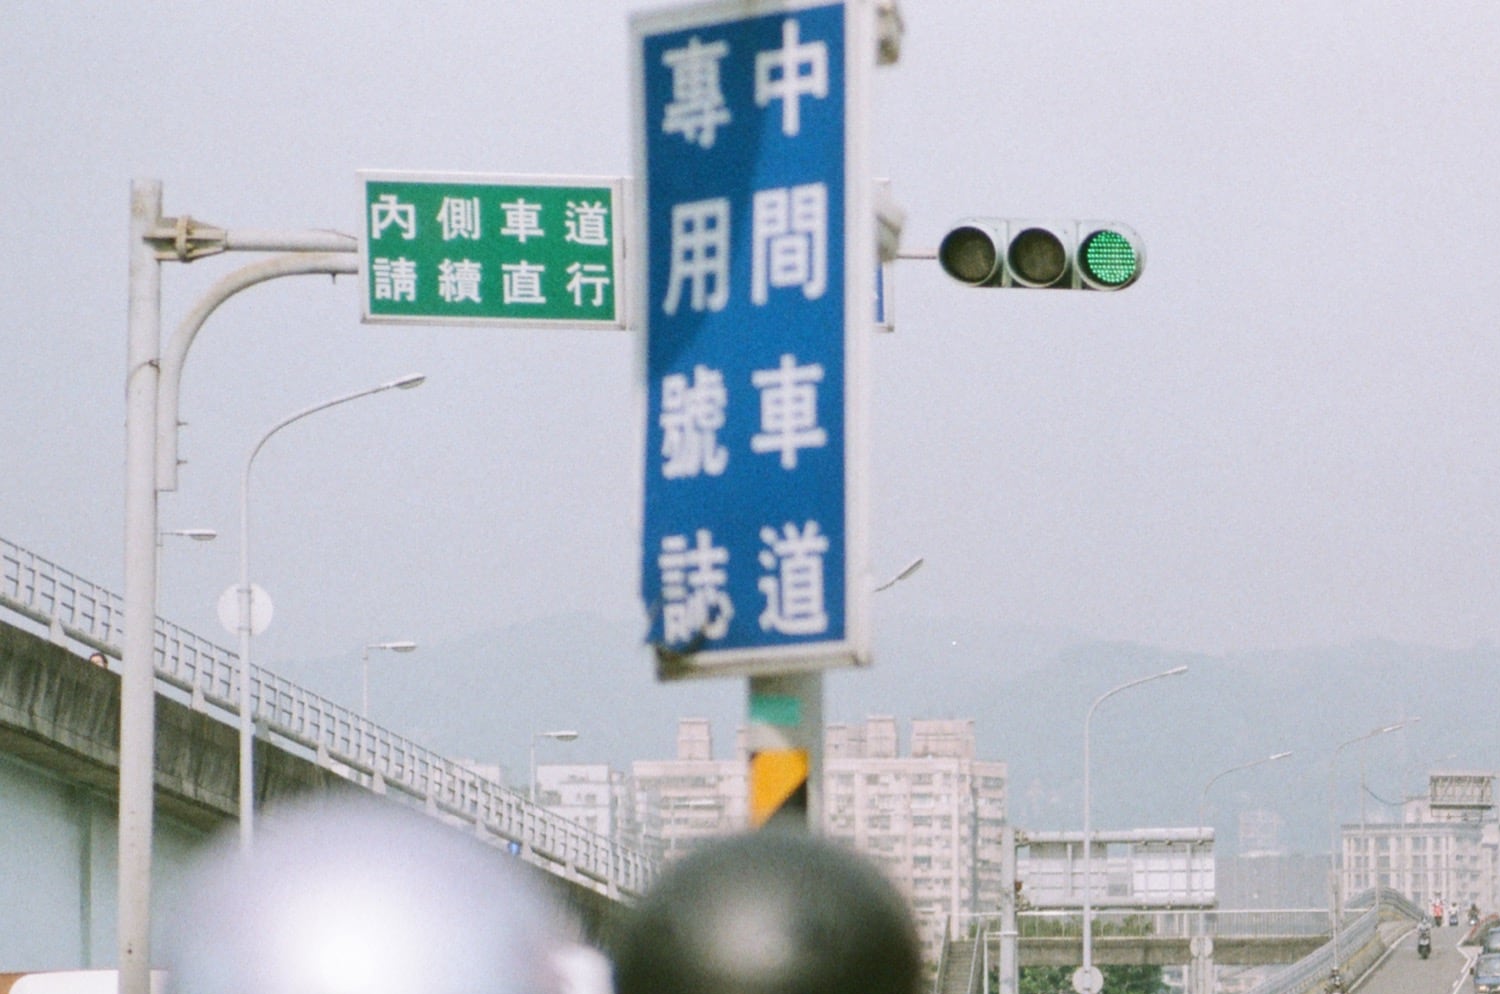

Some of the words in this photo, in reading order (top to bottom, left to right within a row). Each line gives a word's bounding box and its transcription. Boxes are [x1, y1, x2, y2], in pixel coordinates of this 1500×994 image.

[370, 195, 609, 246] 內側車道
[373, 257, 610, 307] 請續直行
[658, 37, 733, 646] 專用號誌
[751, 19, 828, 636] 中間車道
